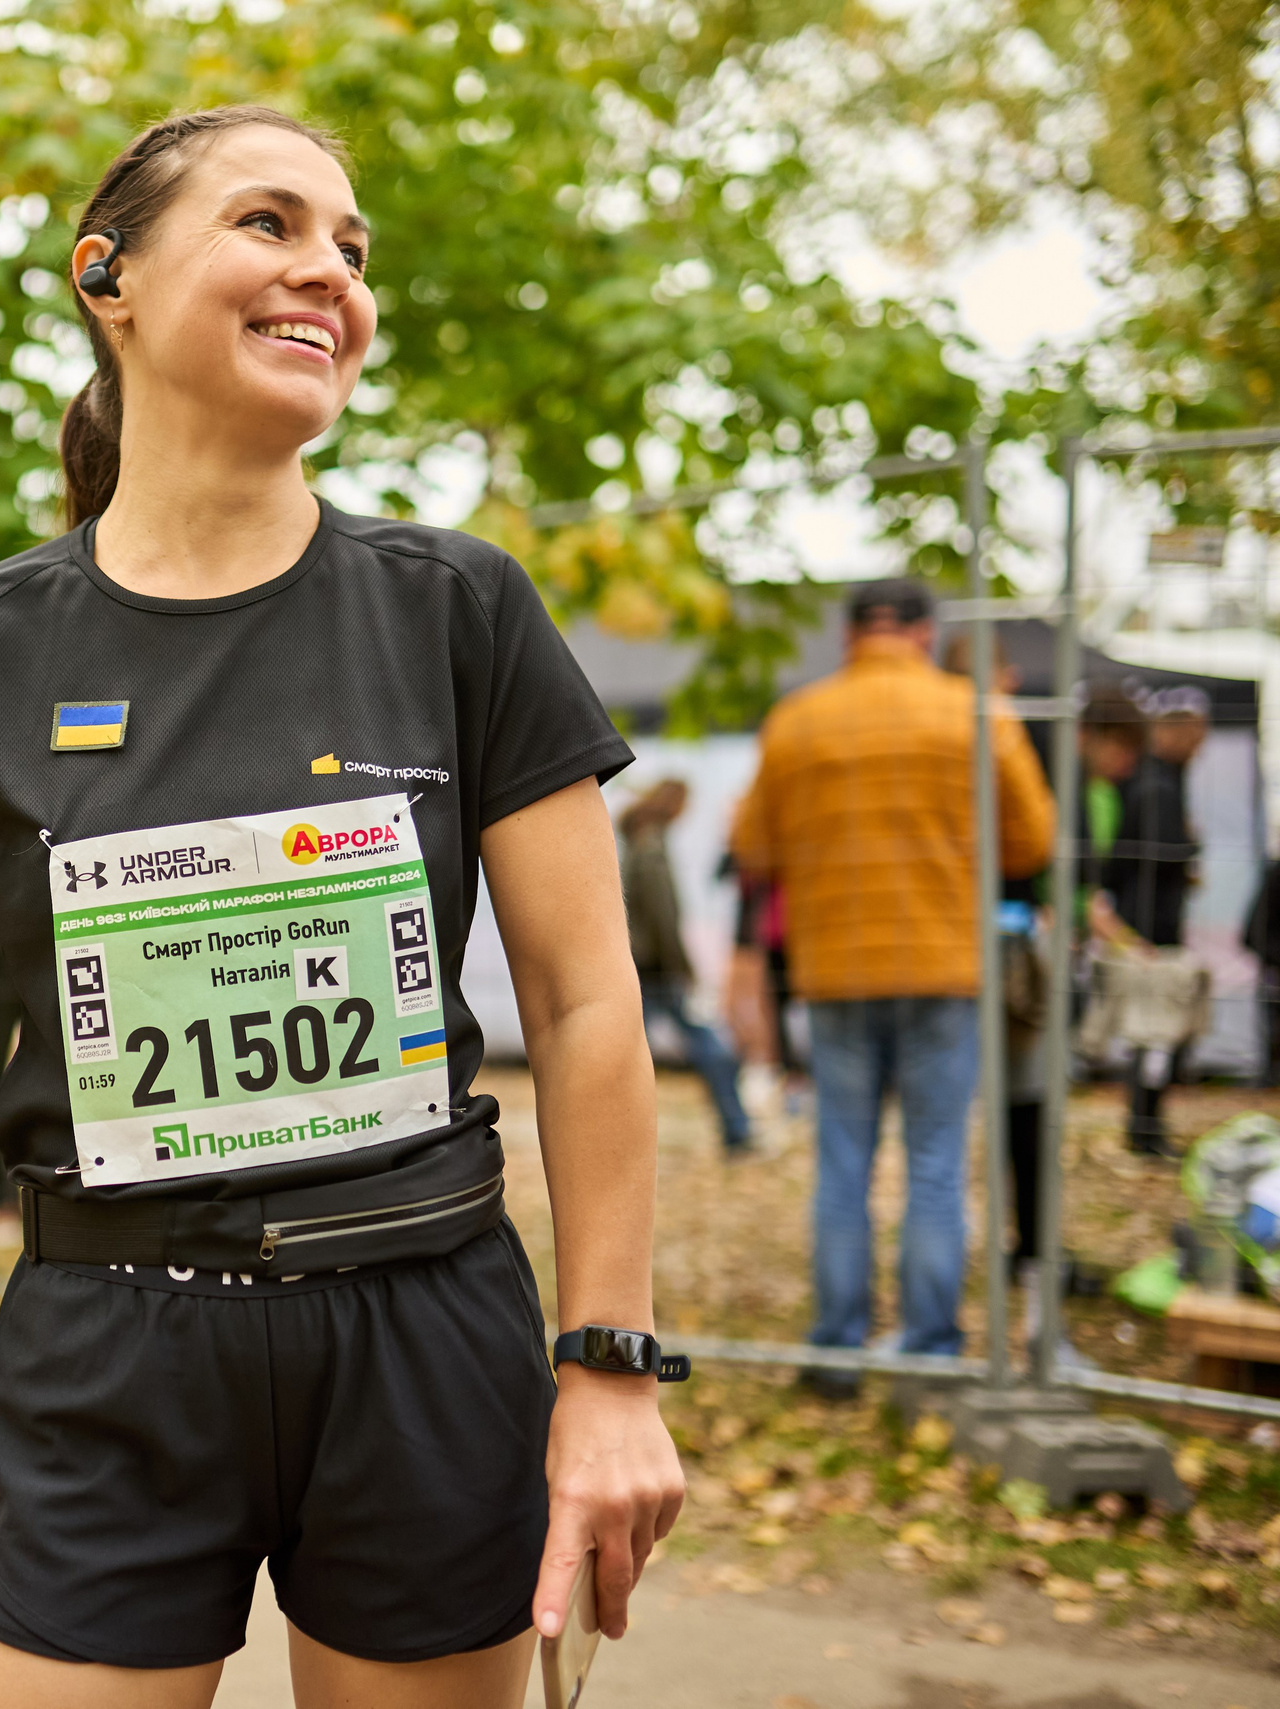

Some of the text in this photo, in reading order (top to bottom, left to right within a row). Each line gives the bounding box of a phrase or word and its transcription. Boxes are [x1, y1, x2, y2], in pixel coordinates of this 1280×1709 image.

[344, 761, 450, 784] смарт простір
[291, 824, 398, 857] АВРОРА
[324, 843, 400, 862] МУЛЬТИМАРКЕТ
[120, 846, 206, 871] UNDER
[60, 869, 422, 932] ДЕНЬ 963: КИЇВСЬКИЙ МАРАФОН НЕЗЛАМНОСТІ 2024
[142, 918, 350, 961] Смарт Простір GoRun
[210, 959, 291, 988] Наталія
[402, 993, 432, 1005] getpica.com
[77, 1042, 110, 1052] getpica.com
[125, 997, 380, 1109] 21502
[79, 1073, 116, 1091] 01:59
[193, 1110, 383, 1159] ПриватБанк
